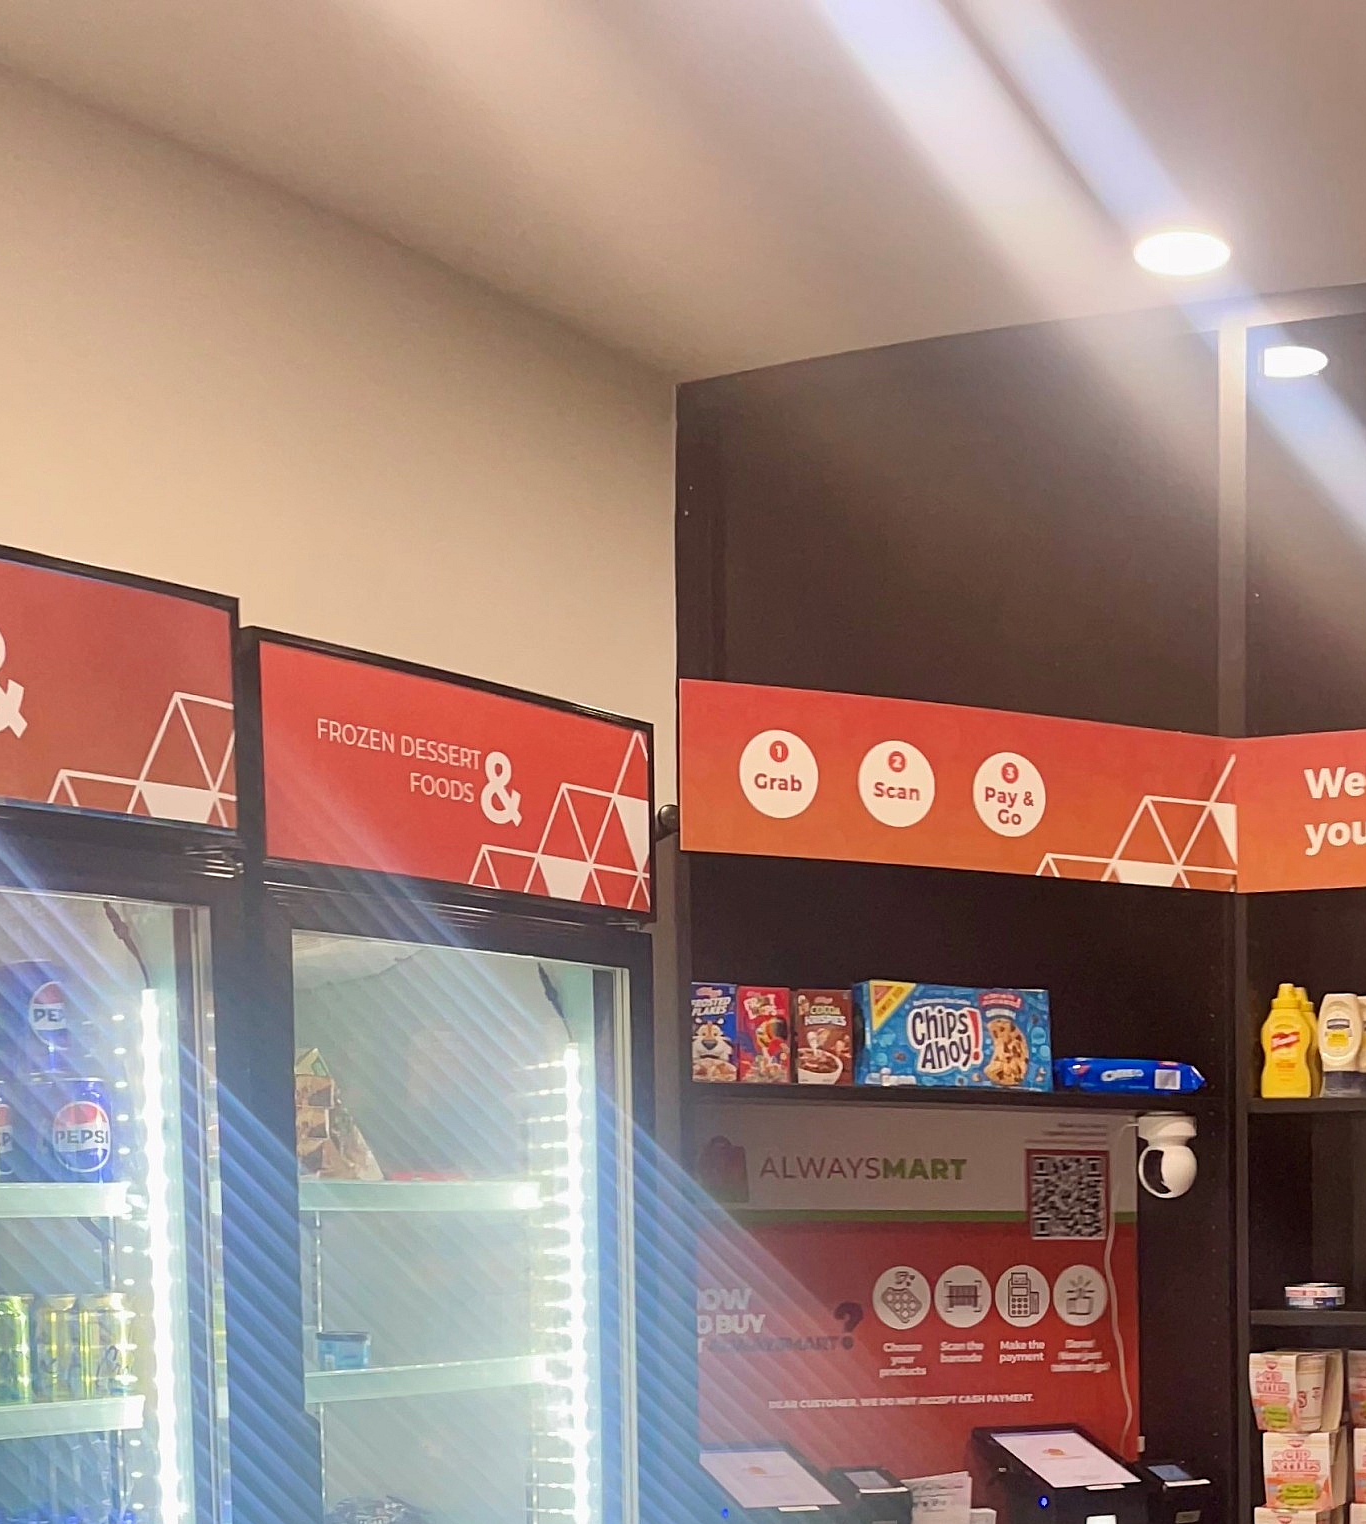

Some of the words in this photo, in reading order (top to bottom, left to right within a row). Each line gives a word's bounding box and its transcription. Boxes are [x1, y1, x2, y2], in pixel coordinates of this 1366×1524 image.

[317, 718, 395, 754] FROZEN
[401, 735, 481, 771] DESSERT
[410, 772, 474, 803] FOODS
[480, 751, 522, 827] &
[754, 772, 802, 794] Grab
[873, 780, 921, 803] Scan
[984, 786, 1018, 808] Pay
[1023, 791, 1035, 807] &
[997, 808, 1022, 827] Go
[912, 1009, 969, 1046] Chips
[55, 1129, 109, 1145] PEPSI
[760, 1155, 967, 1181] ALWAYSMART
[715, 1314, 766, 1334] BUY
[1000, 1340, 1028, 1351] Make
[1029, 1339, 1045, 1350] the
[999, 1351, 1045, 1364] payment
[958, 1394, 985, 1405] CASH
[986, 1393, 1034, 1404] PAYMENT.
